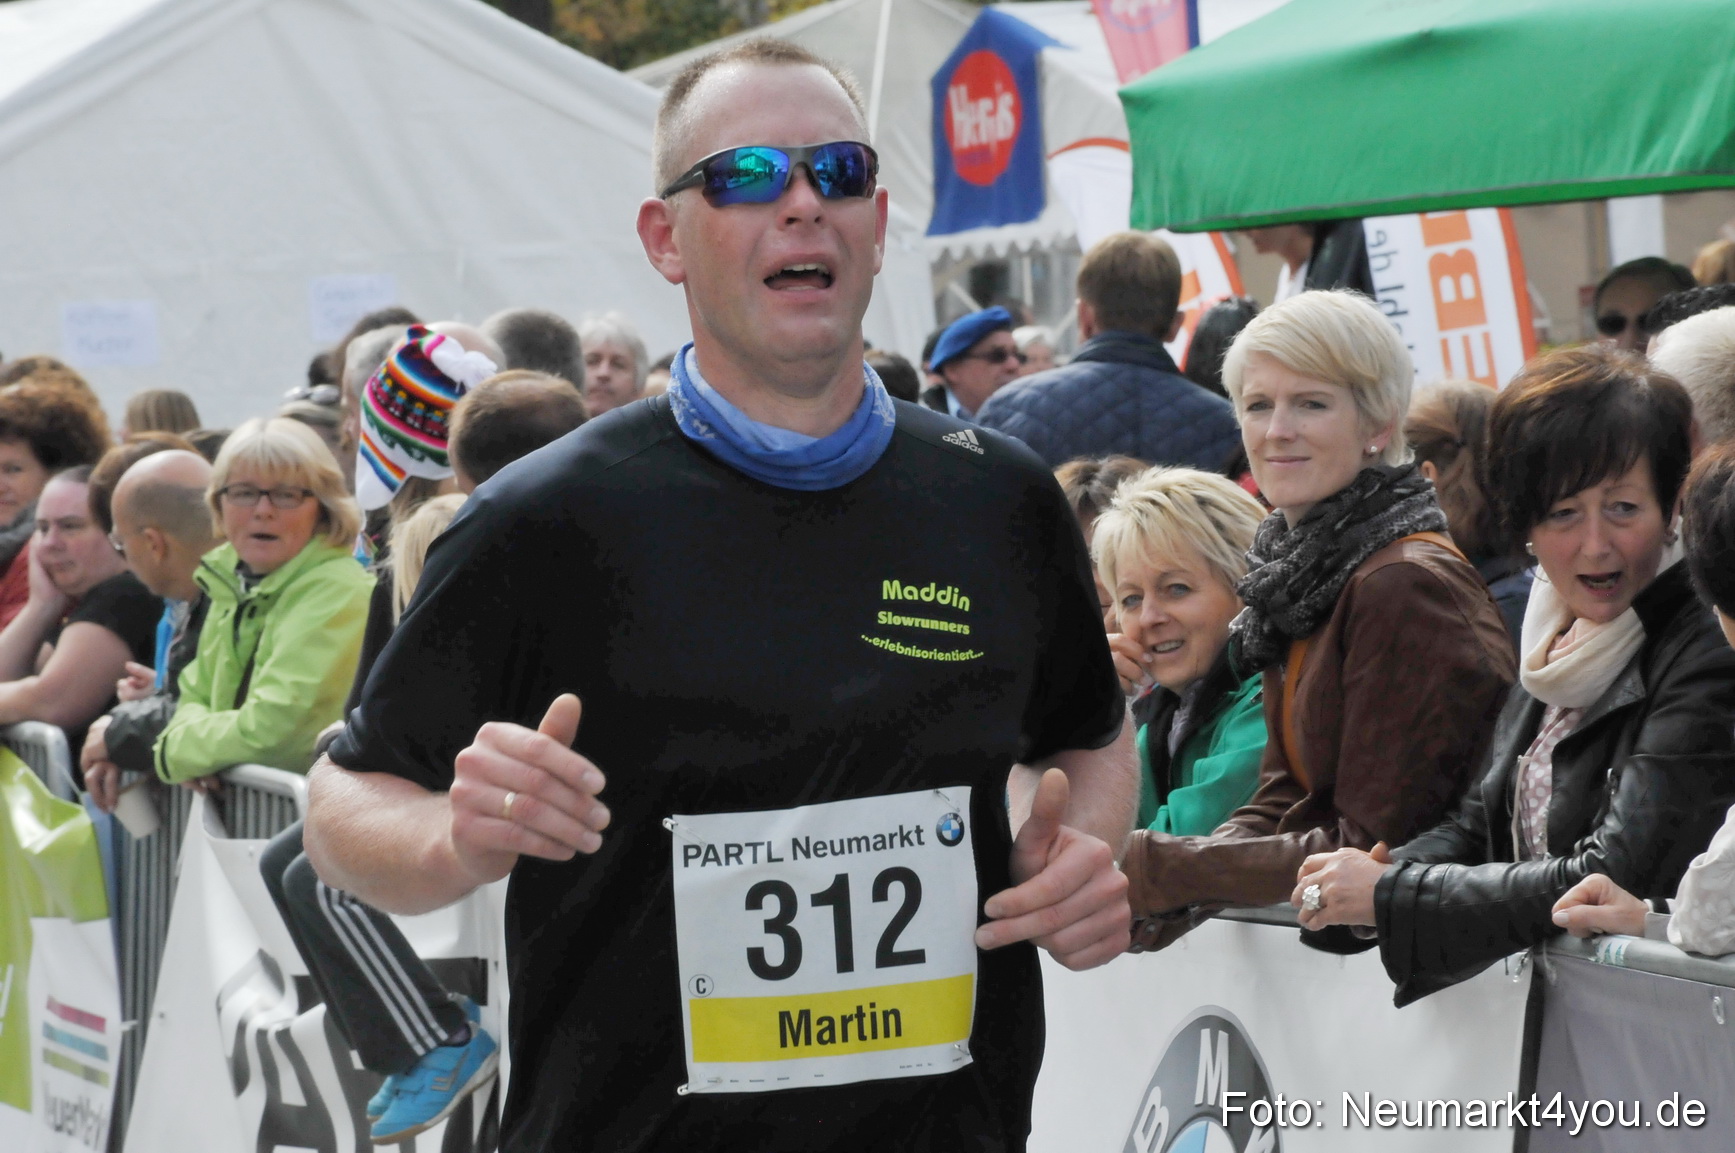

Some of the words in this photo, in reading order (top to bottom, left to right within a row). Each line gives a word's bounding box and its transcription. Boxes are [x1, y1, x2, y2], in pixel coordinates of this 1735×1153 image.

[942, 434, 985, 455] adidas
[882, 579, 971, 612] Maddin
[877, 610, 971, 635] Slowrunners
[682, 840, 784, 868] PARTL
[791, 824, 925, 861] Neumarkt
[744, 866, 927, 982] 312
[778, 1001, 903, 1049] Martin
